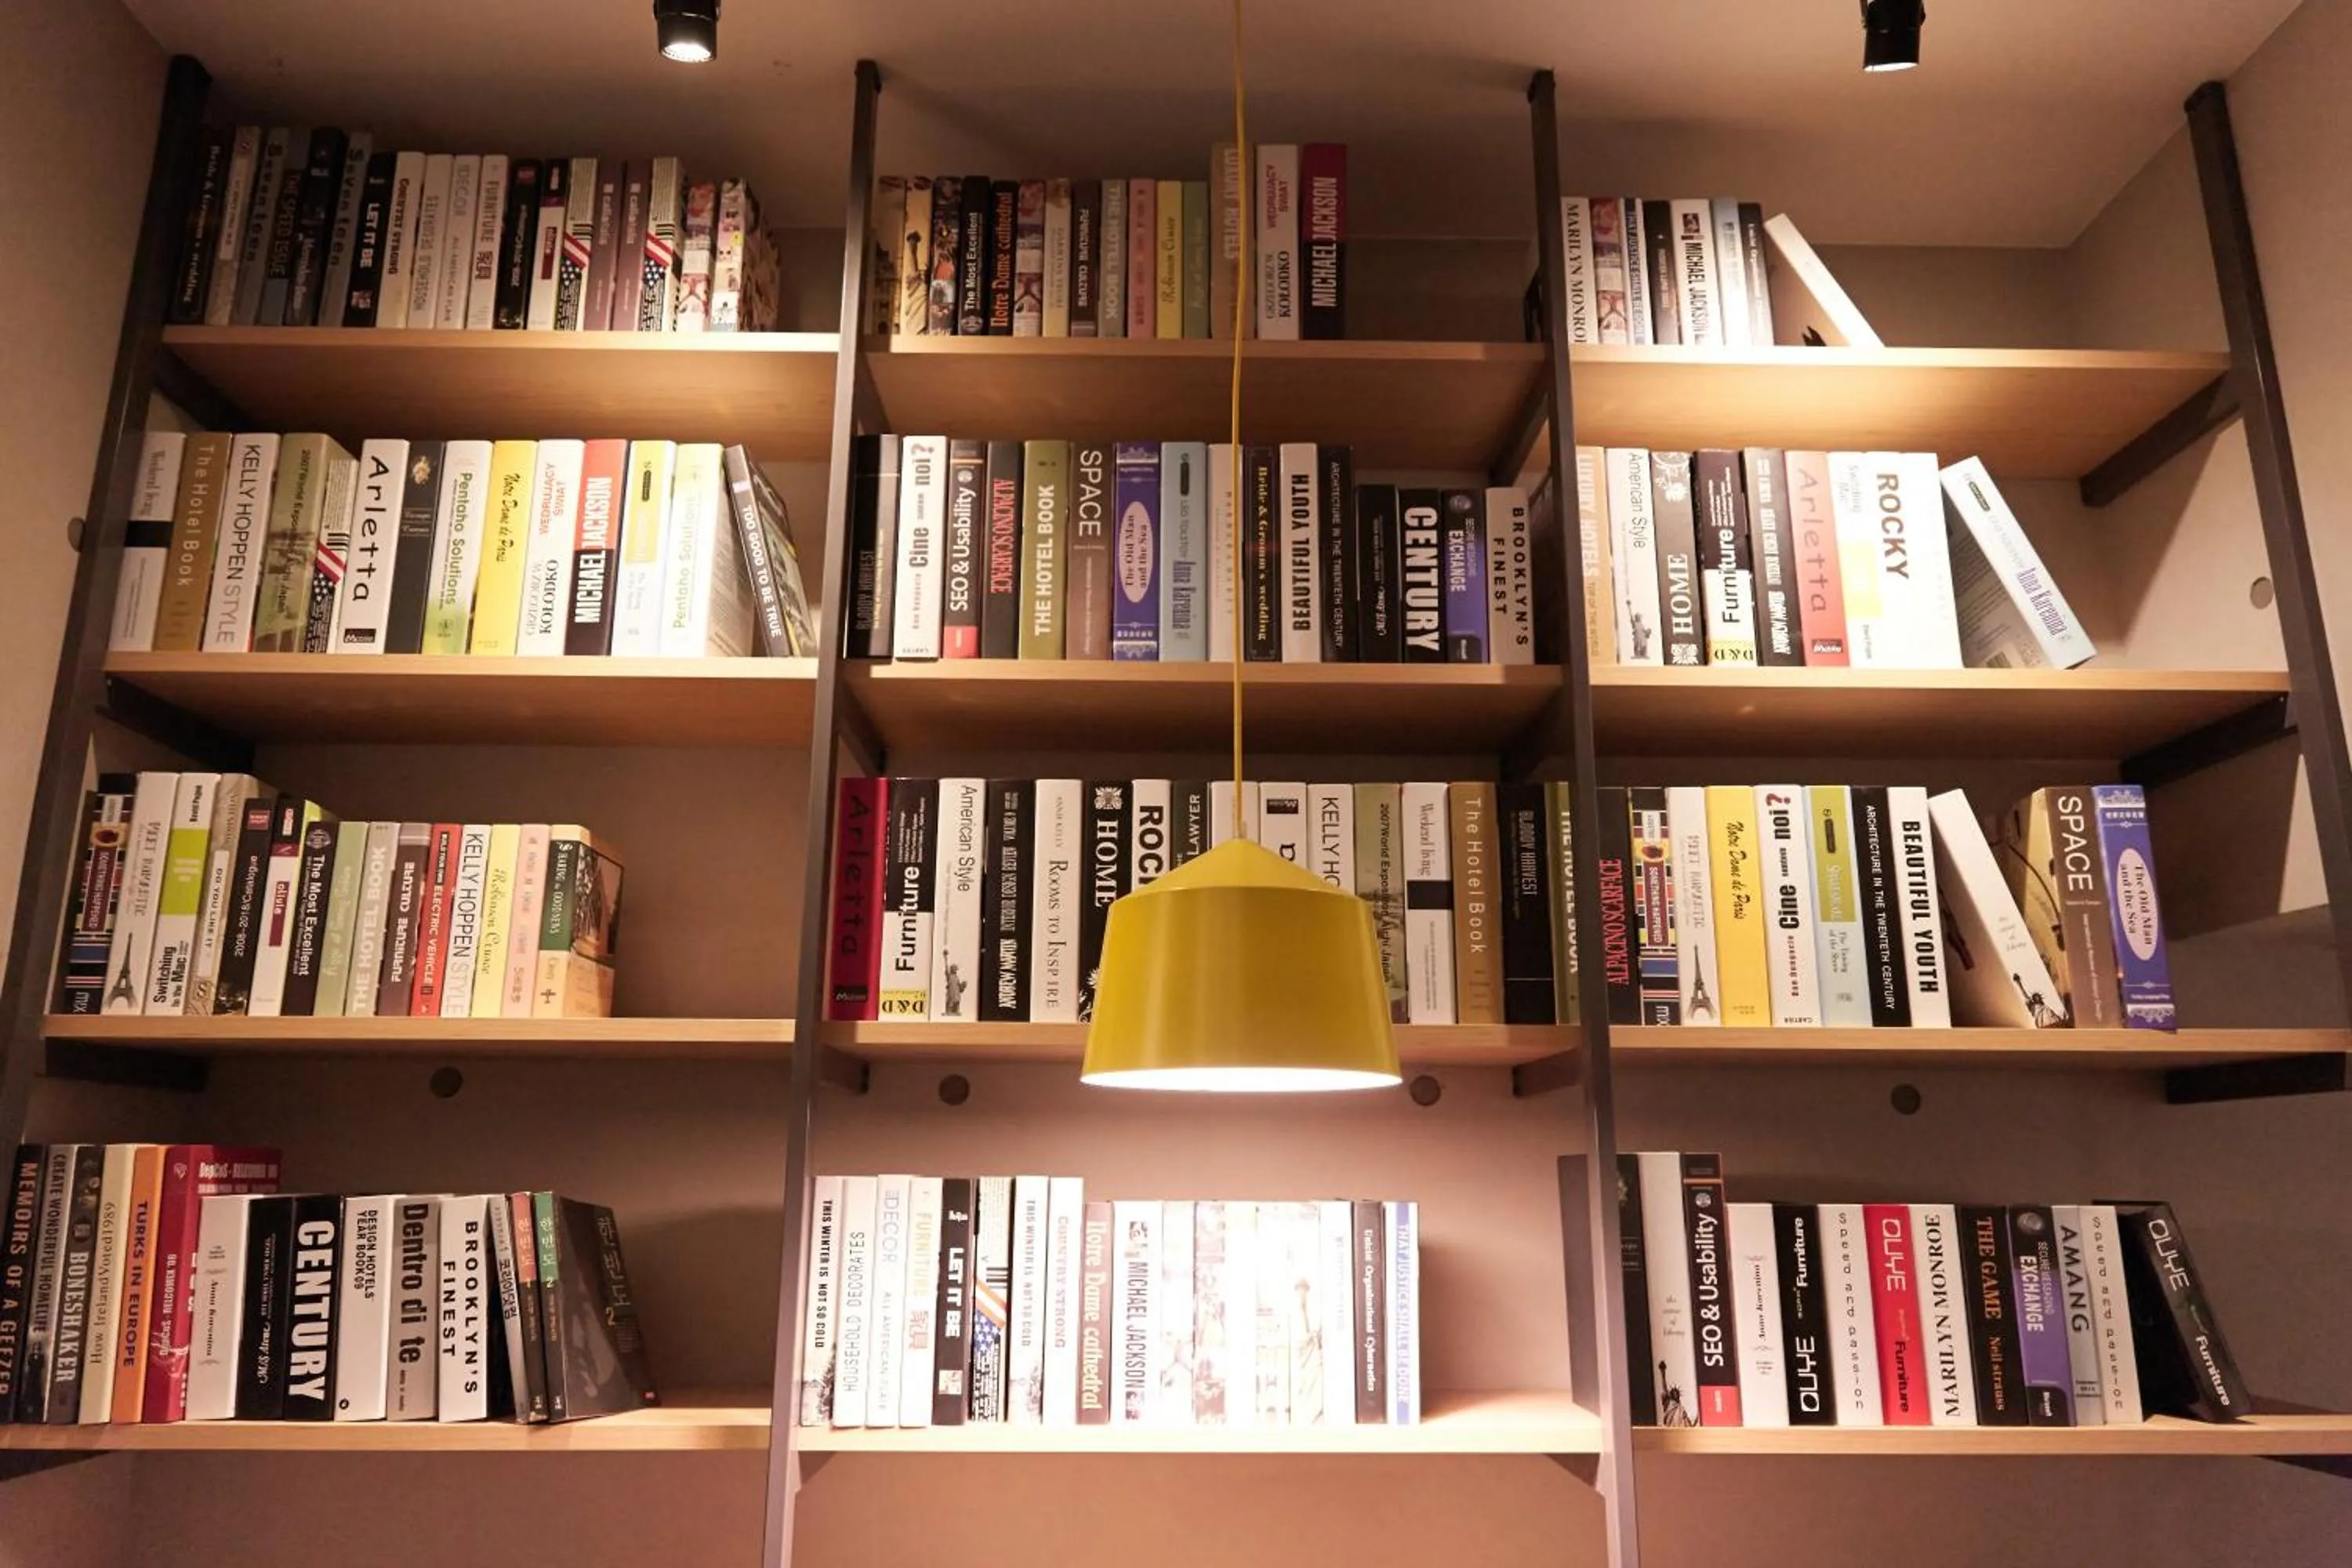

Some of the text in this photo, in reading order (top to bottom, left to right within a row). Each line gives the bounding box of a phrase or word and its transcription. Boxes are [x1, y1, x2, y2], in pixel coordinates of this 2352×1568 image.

[360, 202, 382, 268] LET IT BE
[964, 212, 979, 311] The Most Excellent
[1105, 185, 1121, 320] THE HOTEL BOOK
[1312, 176, 1338, 307] MICHAEL JACKSON
[1567, 203, 1583, 275] MARILYN
[1684, 241, 1711, 333] MICHAEL JACKSON
[176, 444, 214, 586] The Book
[216, 444, 262, 644] KELLY HOPPEN STYLE
[352, 455, 390, 602] Arletta
[453, 472, 474, 533] Pentaho
[1078, 449, 1104, 538] SPACE
[1629, 452, 1650, 549] American Style
[1798, 468, 1830, 612] Arletta
[1876, 474, 1911, 580] ROCKY
[445, 538, 466, 606] Solutions
[574, 476, 613, 624] MICHAEL JACKSON
[742, 503, 782, 639] TOO GOOD TO BE TRUE
[909, 527, 930, 568] Cine
[949, 486, 977, 612] SEO & Usability
[1034, 484, 1055, 637] THE HOTEL BOOK
[1256, 466, 1270, 641] Bride & wedding
[1291, 474, 1312, 631] BEAUTIFUL YOUTH
[1404, 506, 1440, 652] CENTURY
[1448, 529, 1468, 593] EXCHANGE
[1493, 536, 1508, 615] FINEST
[1512, 506, 1530, 647] BROOKLYN'S
[1667, 554, 1694, 635] HOME
[1718, 528, 1741, 623] Furniture
[954, 784, 978, 892] American Style
[1094, 818, 1119, 909] HOME
[1185, 793, 1202, 857] LAWYER
[1321, 797, 1340, 856] KELLY
[1520, 851, 1537, 895] HARVEST
[1725, 820, 1751, 920] Notre Dame de Paris
[2057, 795, 2094, 891] SPACE
[298, 855, 325, 976] The Most Excellent
[357, 847, 387, 969] HOTEL BOOK
[452, 832, 485, 956] KELLY HOPPEN
[895, 866, 921, 972] Furniture
[1465, 797, 1487, 956] The Hotel Book
[1778, 884, 1801, 930] Cine
[1866, 805, 1896, 1010] ARCHITECTURE IN THE CENTURY
[1901, 820, 1940, 993] BEAUTIFUL YOUTH
[2120, 863, 2140, 934] and the Sea
[2133, 864, 2154, 945] The Old Man
[152, 947, 177, 1004] Switching
[170, 956, 188, 983] Mac
[423, 884, 446, 985] ELECTRIC VEHICLE
[2, 1161, 38, 1310] MEMOIRS OF A
[31, 1153, 68, 1334] CREATE WONDERFUL HOMELIFE
[355, 1210, 368, 1240] YEAR
[364, 1209, 378, 1300] DESIGN HOTELS
[815, 1199, 833, 1348] THIS WINTER IS NOT SO COLD
[1023, 1200, 1036, 1276] THIS WINTER IS
[1792, 1217, 1809, 1288] Furniture
[1976, 1215, 2003, 1319] THE GAME
[55, 1251, 91, 1382] BONESHAKER
[123, 1200, 151, 1367] TURKS IN EUROPE
[287, 1220, 336, 1401] CENTURY
[398, 1203, 429, 1364] Dentro di te
[442, 1260, 456, 1357] FINEST
[464, 1221, 479, 1395] BROOKLYN'S
[842, 1231, 866, 1392] HOUSEHOLD DECORATES
[909, 1309, 930, 1349] 家具
[945, 1247, 965, 1337] LET IT BE
[1054, 1288, 1067, 1348] STRONG
[1083, 1272, 1108, 1321] Dame
[1124, 1260, 1149, 1388] MICHAEL JACKSON
[1397, 1221, 1410, 1365] THAT JUSTICE BE
[1694, 1212, 1724, 1367] SEO & Usability
[1925, 1214, 1962, 1417] MARILYN MONROE
[2019, 1254, 2045, 1333] EXCHANGE
[2060, 1225, 2091, 1333] AMANG
[90, 1333, 105, 1364] How
[1893, 1340, 1911, 1412] Furniture
[1988, 1336, 2003, 1361] Neil
[2194, 1334, 2231, 1406] Furniture
